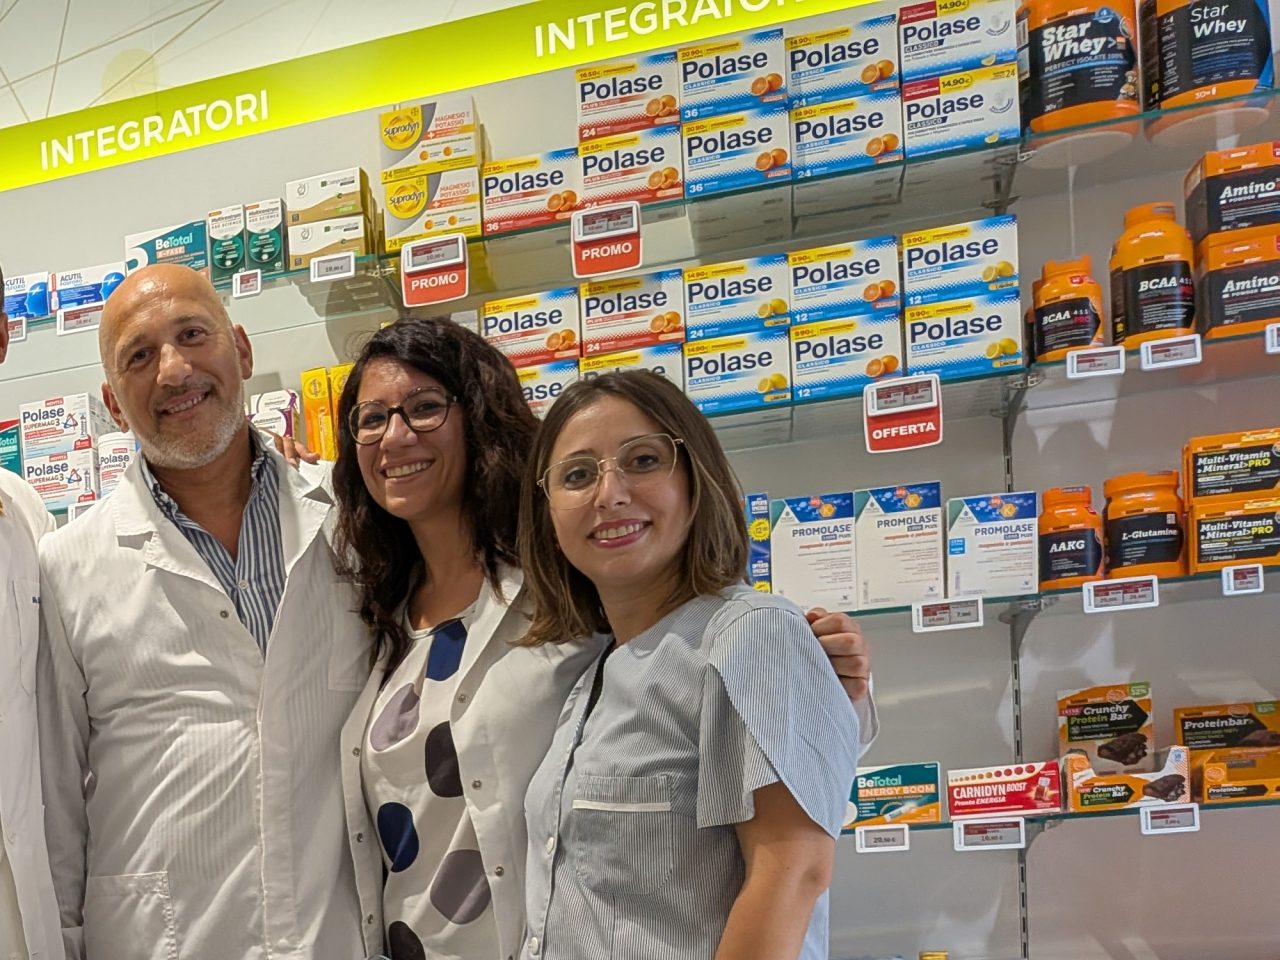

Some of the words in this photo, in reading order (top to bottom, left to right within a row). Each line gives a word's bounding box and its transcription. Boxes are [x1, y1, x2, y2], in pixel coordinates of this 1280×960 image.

[1190, 5, 1229, 22] Star
[535, 0, 806, 57] INTEGRAT
[903, 16, 981, 44] Polase
[1042, 21, 1092, 47] Star
[1193, 19, 1247, 38] Whey
[790, 37, 880, 72] Polase
[682, 51, 768, 82] Polase
[1006, 69, 1016, 77] 24
[580, 74, 663, 103] Polase
[684, 109, 698, 118] 36
[906, 94, 984, 122] Polase
[435, 112, 465, 122] MAGNESIO
[435, 119, 464, 129] POTASSIO
[40, 90, 269, 170] INTEGRATORI
[384, 121, 420, 137] Supradyn
[582, 128, 596, 138] 24
[795, 111, 884, 142] Polase
[687, 126, 773, 157] Polase
[583, 146, 665, 176] Polase
[797, 169, 811, 178] 24
[485, 169, 564, 197] Polase
[689, 184, 703, 192] 36
[1220, 181, 1276, 199] Amino
[389, 189, 425, 205] Supradyn
[486, 223, 499, 231] 36
[155, 232, 193, 250] BeTotal
[582, 243, 632, 261] PROMO
[907, 238, 999, 269] Polase
[60, 272, 83, 282] ACUTIL
[793, 258, 880, 287] Polase
[6, 277, 26, 287] CUTIL
[411, 272, 459, 290] PROMO
[688, 275, 773, 303] Polase
[1138, 276, 1178, 292] BCAA
[1222, 275, 1279, 293] Amino
[585, 290, 668, 317] Polase
[909, 296, 922, 304] 12
[484, 308, 562, 336] Polase
[795, 313, 808, 321] 12
[1042, 310, 1071, 325] BCAA
[690, 330, 704, 338] 24
[911, 313, 1002, 343] Polase
[587, 343, 600, 352] 24
[795, 333, 883, 361] Polase
[688, 350, 773, 378] Polase
[797, 389, 810, 397] 12
[22, 407, 65, 424] Polase
[23, 420, 55, 430] SUPERMAG
[872, 421, 937, 440] OFFERTA
[100, 454, 130, 466] Polase
[1197, 450, 1271, 466] Multi-Vitamin
[26, 462, 69, 478] Polase
[28, 475, 59, 485] SUPERMAG
[877, 513, 939, 528] PROMOLASE
[1200, 518, 1274, 533] Multi-Vitamin
[792, 523, 852, 538] PROMOLASE
[975, 523, 1034, 537] PROMOLASE
[1121, 528, 1178, 541] L-Glutamine
[1049, 540, 1086, 553] AAKG
[1083, 704, 1130, 717] Crunchy
[1070, 714, 1108, 725] Protein
[857, 774, 902, 788] BeTotal
[858, 786, 900, 798] ENERGY
[903, 783, 936, 794] BOOM
[953, 784, 1006, 800] CARNIDYN
[1006, 782, 1027, 793] BOOST
[975, 796, 1006, 805] ENERGIA
